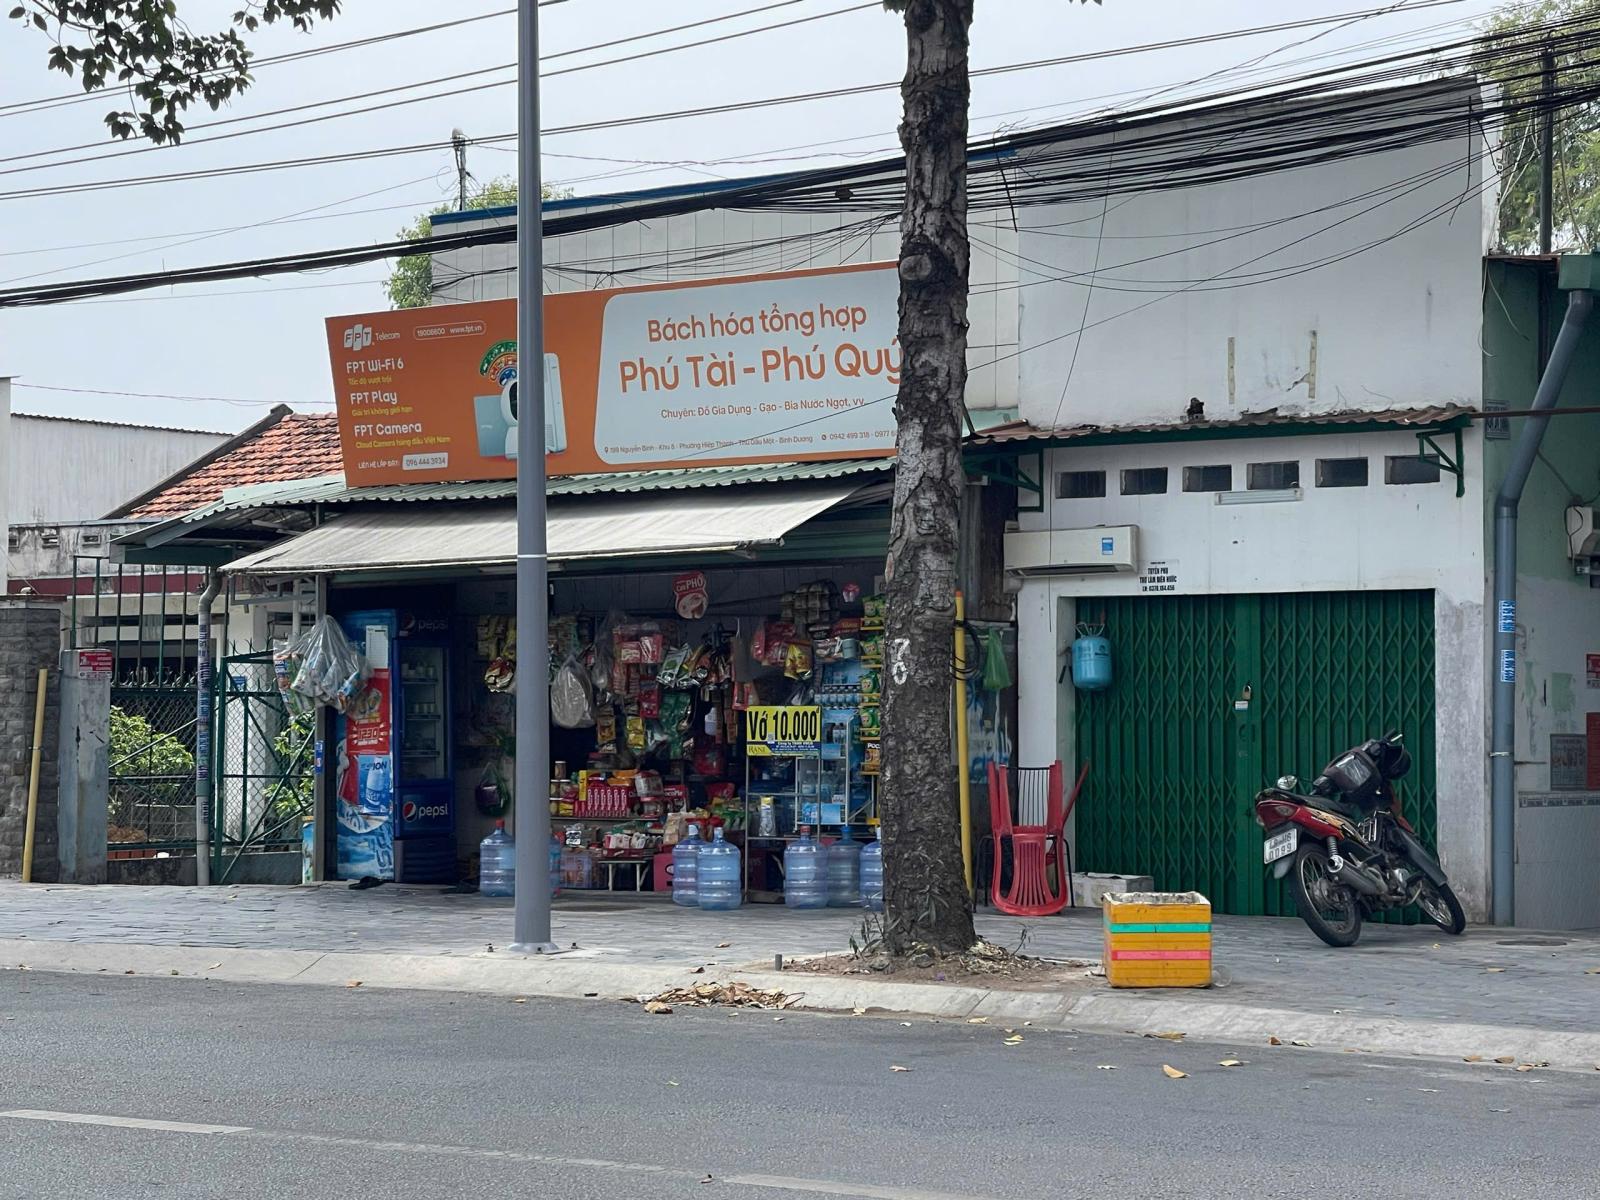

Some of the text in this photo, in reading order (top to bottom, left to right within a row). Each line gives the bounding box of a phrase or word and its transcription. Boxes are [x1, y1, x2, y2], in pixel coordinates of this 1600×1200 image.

[648, 303, 867, 342] Bách hóa tổng hợp
[376, 332, 400, 341] Telecom
[346, 357, 404, 374] FPT Wi-Fi 6
[619, 355, 680, 393] Phú
[686, 351, 737, 388] Tài
[761, 344, 826, 383] Phú
[350, 389, 398, 405] FPT Play
[661, 408, 696, 420] Chuyên:
[711, 405, 726, 416] Gia
[727, 404, 752, 417] Dụng
[759, 402, 777, 413] Gạo
[784, 400, 799, 411] Bia
[800, 398, 824, 410] Nước
[354, 422, 422, 437] FPT Camera
[405, 458, 418, 466] 096
[418, 618, 448, 632] pepsi
[748, 710, 768, 740] Vớ
[418, 803, 448, 821] pepsi
